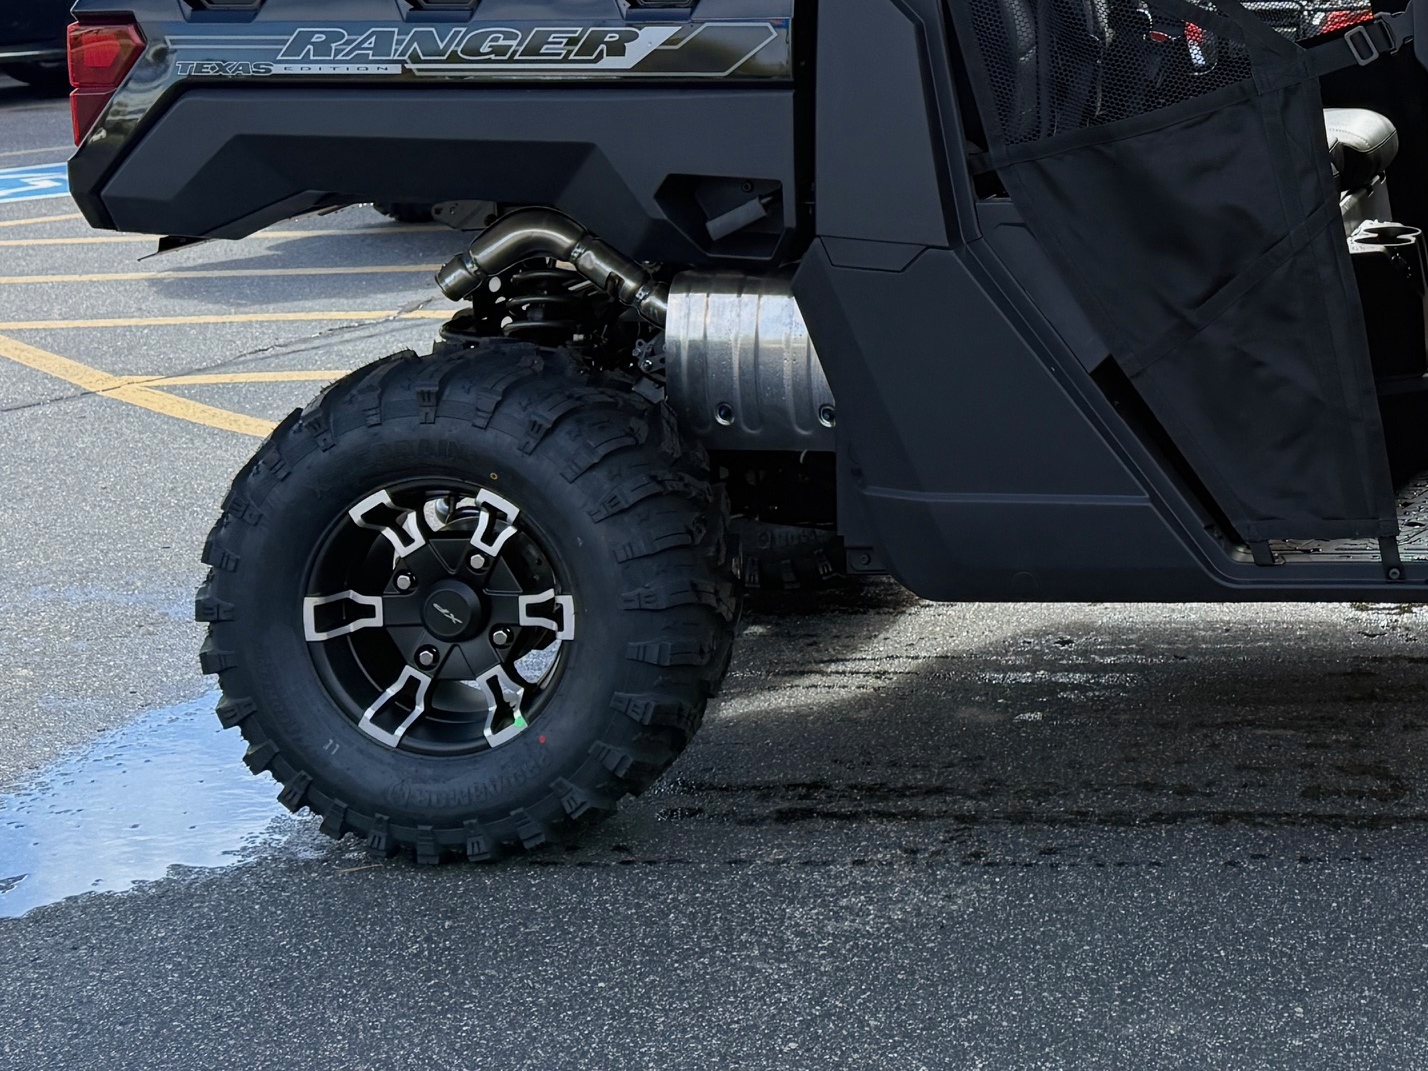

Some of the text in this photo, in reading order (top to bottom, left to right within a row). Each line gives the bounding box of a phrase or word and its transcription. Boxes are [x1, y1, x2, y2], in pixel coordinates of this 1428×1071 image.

[277, 27, 642, 60] RANGER
[176, 61, 390, 77] TEXAS EDITION
